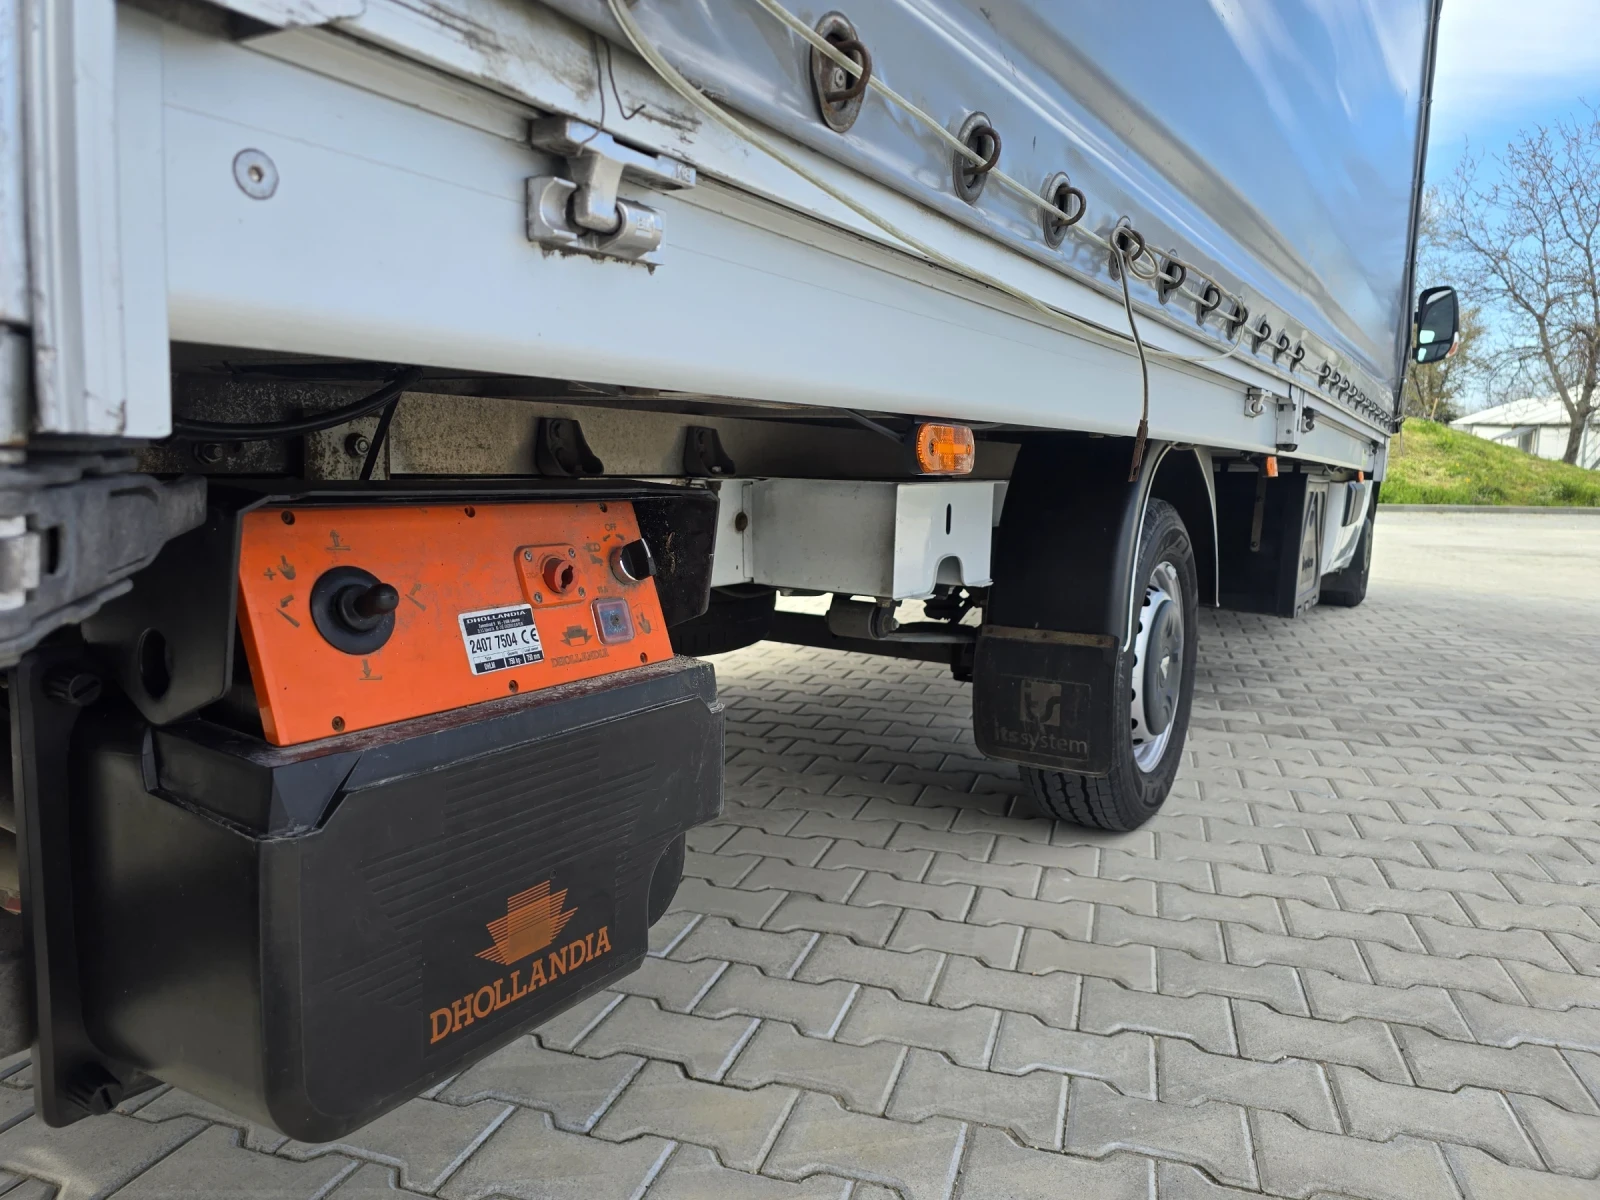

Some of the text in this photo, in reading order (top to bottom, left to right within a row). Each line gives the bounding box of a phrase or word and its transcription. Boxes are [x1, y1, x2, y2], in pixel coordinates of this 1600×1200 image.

[604, 522, 617, 532] OFF
[466, 610, 526, 624] DHOLLANDIA
[469, 637, 492, 654] 2407
[494, 632, 518, 649] 7504
[551, 648, 610, 668] DHOLLANDIA
[430, 925, 612, 1045] DHOLLANDIA
